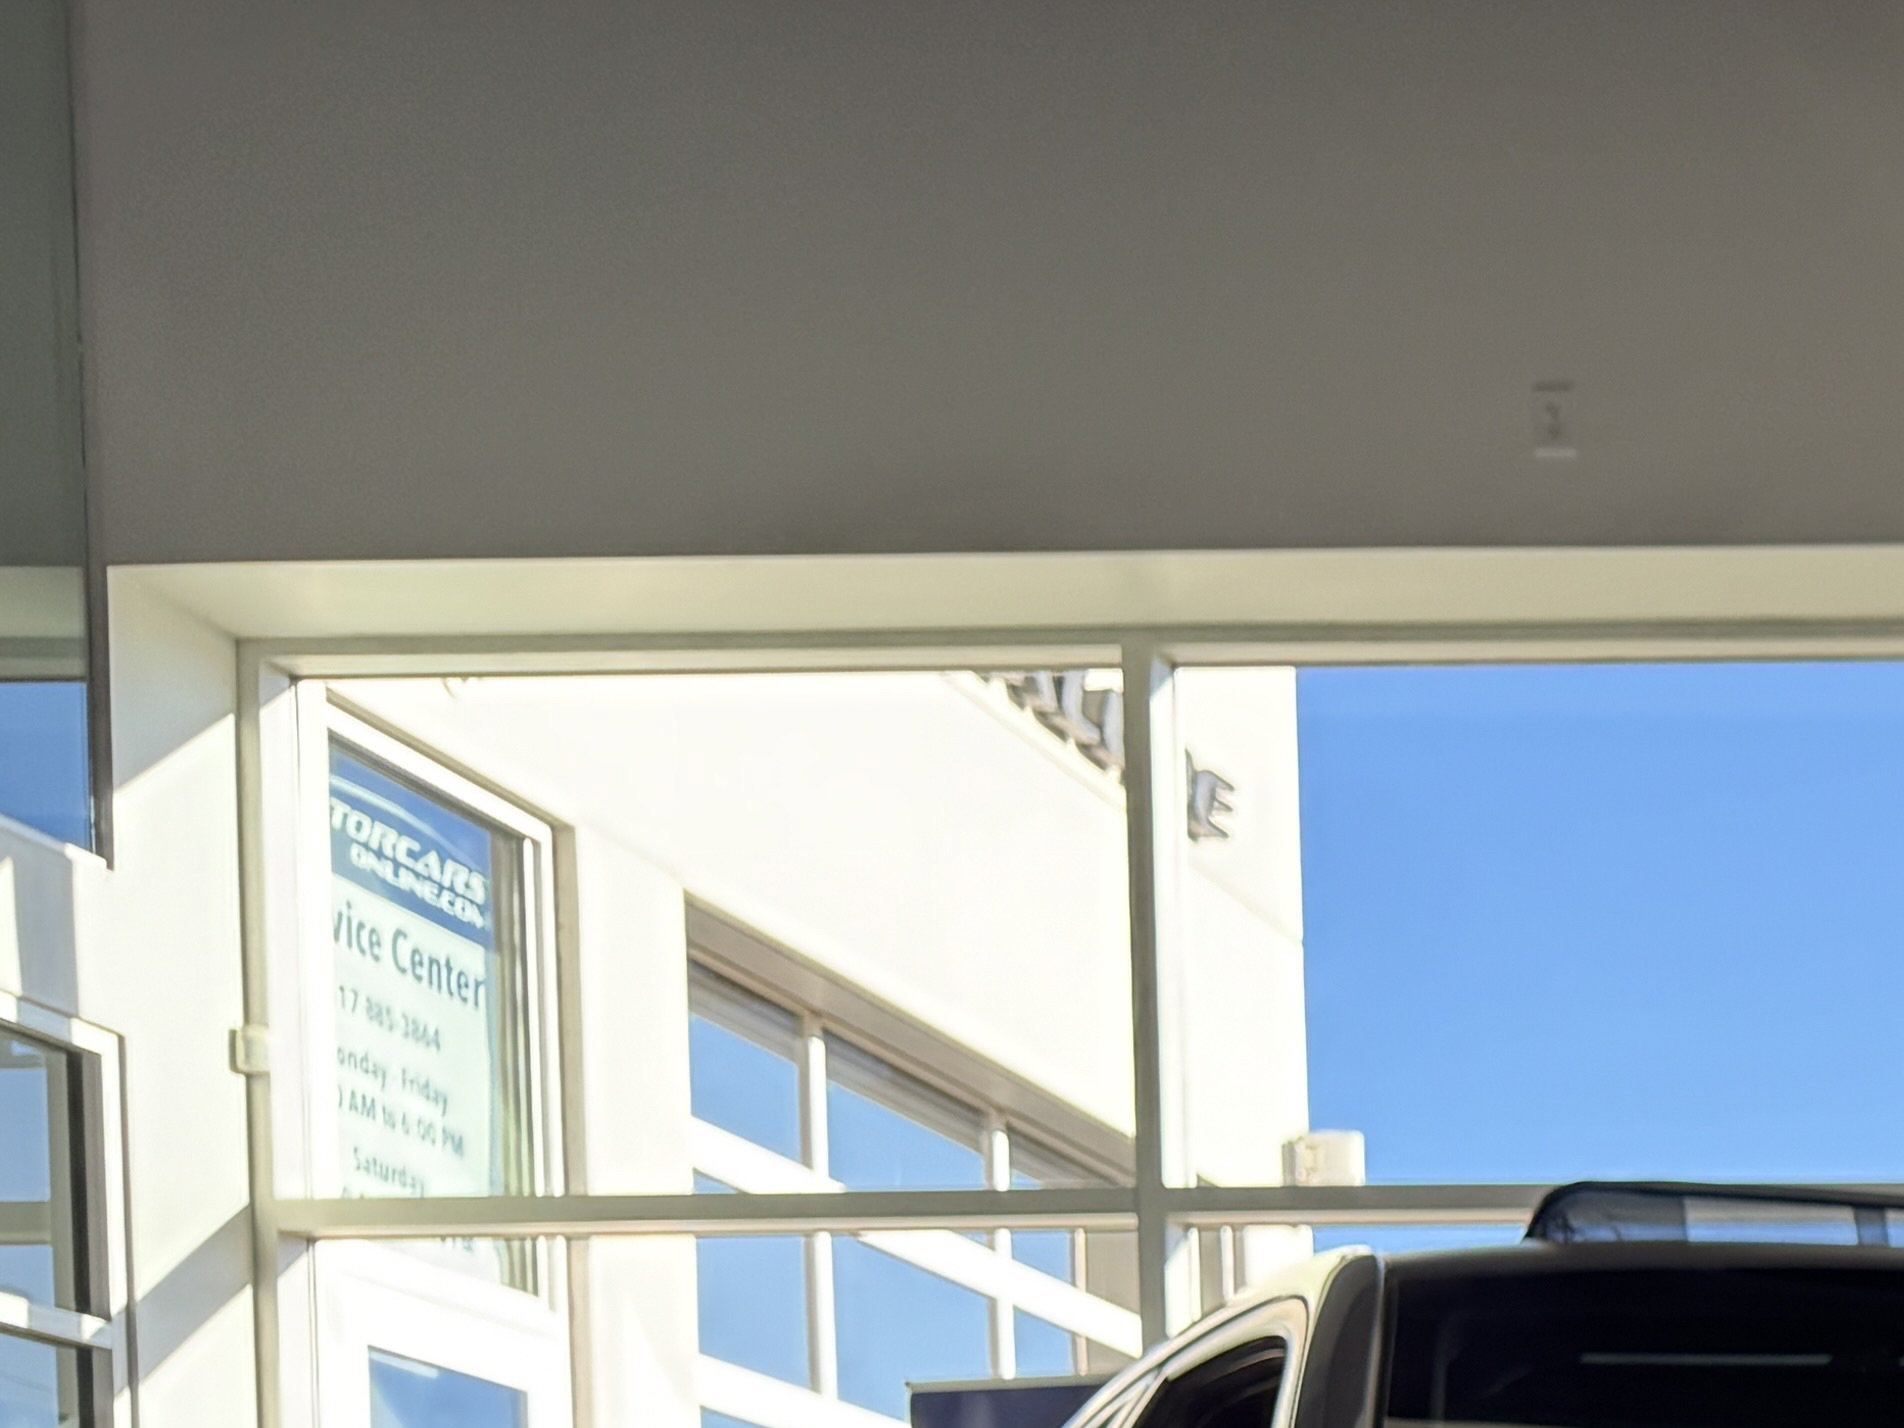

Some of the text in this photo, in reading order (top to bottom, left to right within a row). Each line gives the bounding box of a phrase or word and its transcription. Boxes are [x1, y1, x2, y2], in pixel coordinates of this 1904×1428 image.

[391, 928, 485, 1009] Center
[349, 1087, 377, 1122] AM
[441, 1124, 466, 1161] PM
[353, 1145, 426, 1199] Saturday
